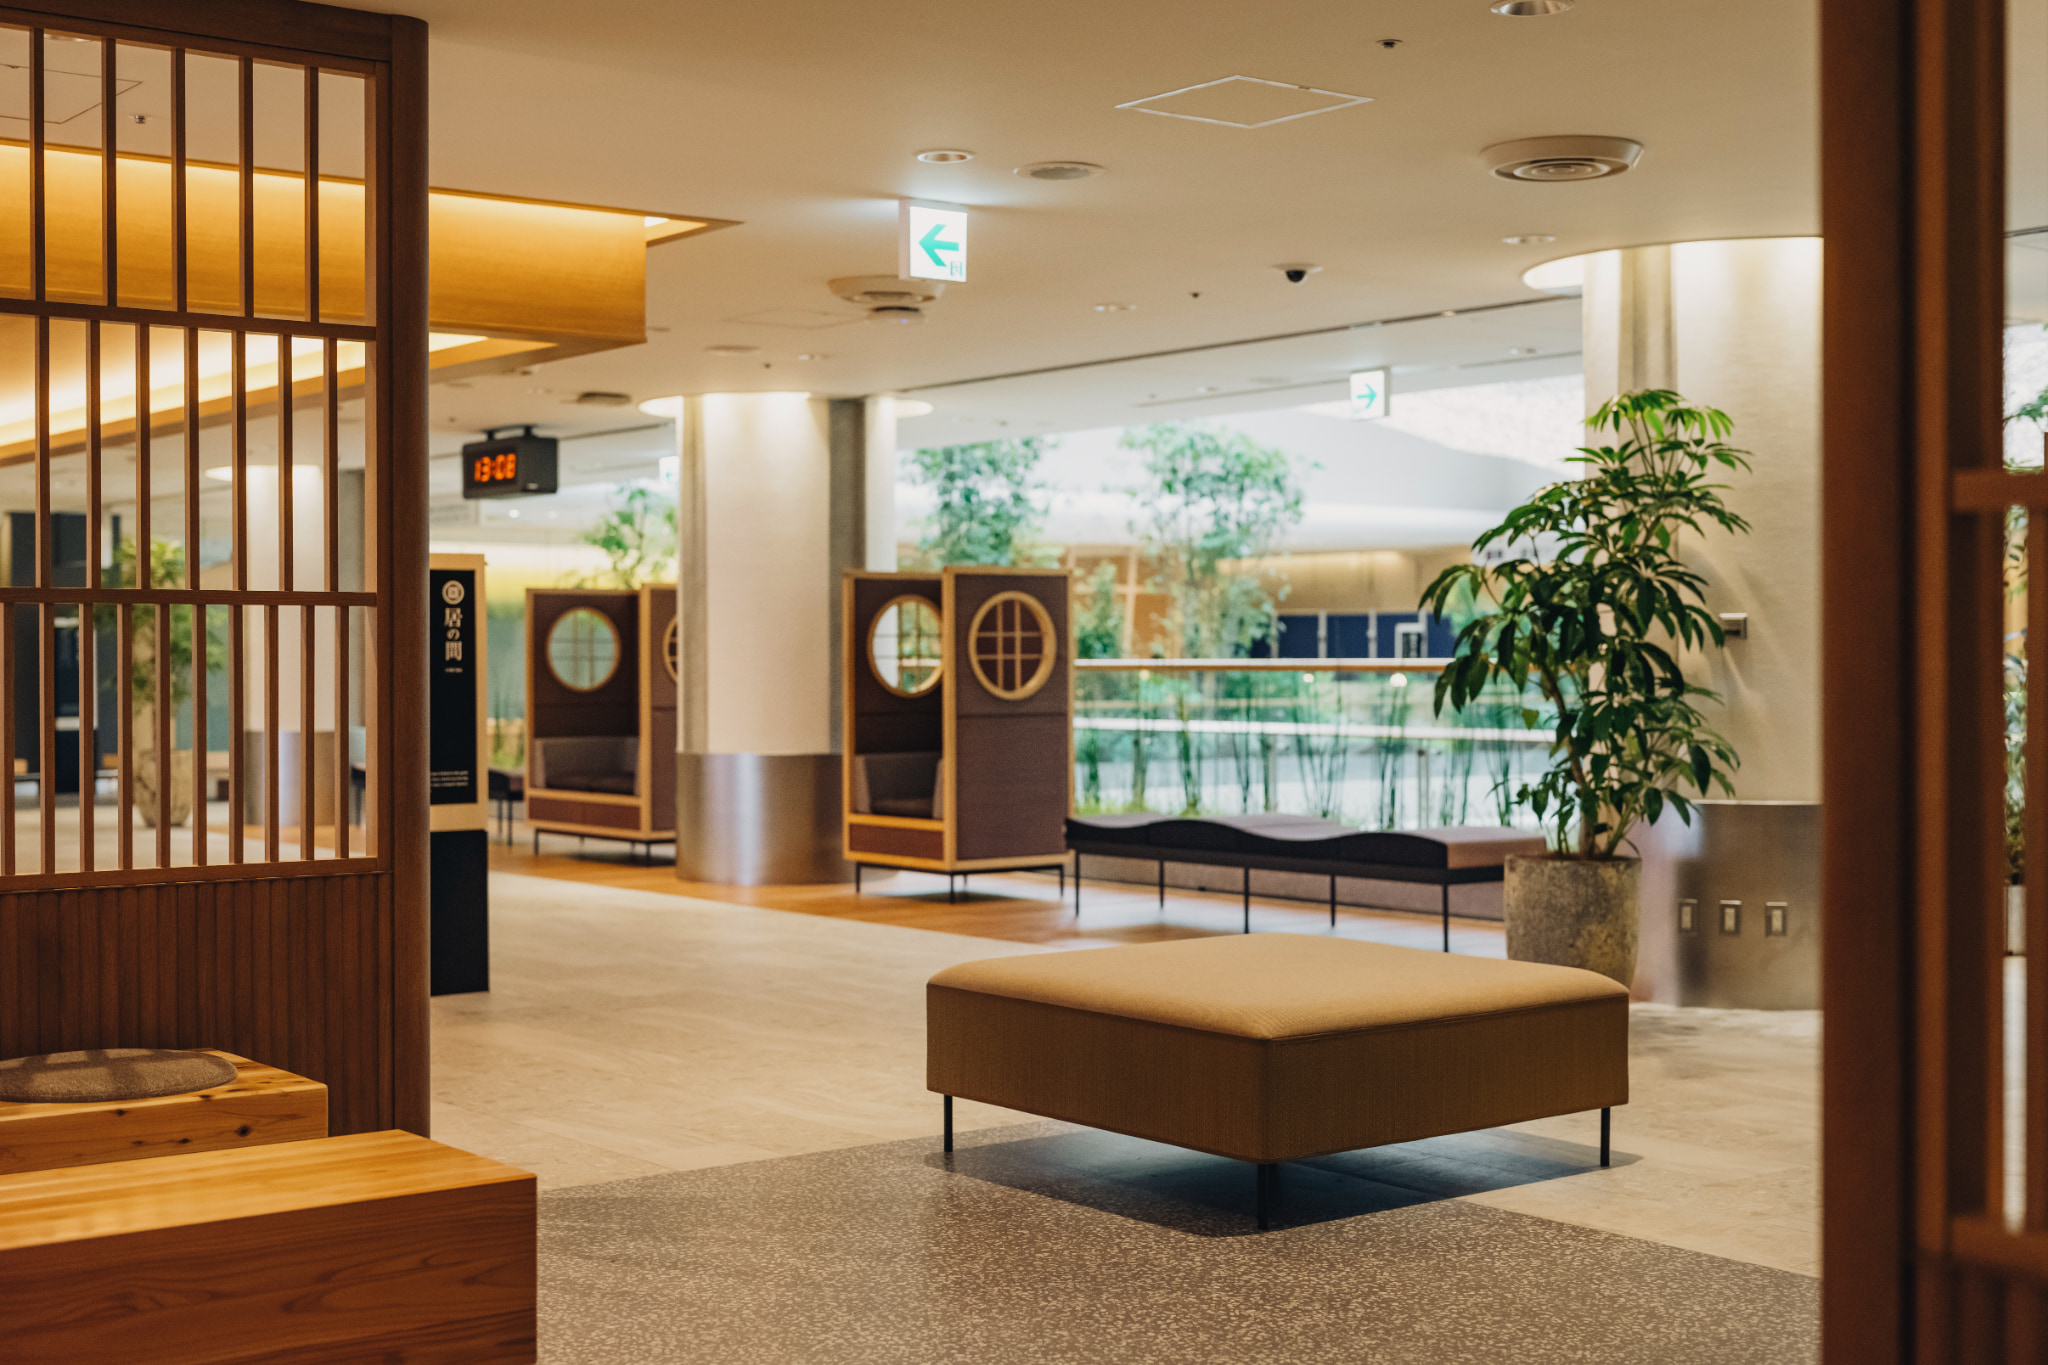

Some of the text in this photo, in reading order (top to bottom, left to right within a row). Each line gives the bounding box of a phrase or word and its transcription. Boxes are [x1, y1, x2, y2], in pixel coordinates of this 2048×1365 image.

[474, 453, 516, 482] 13:08
[444, 607, 463, 661] 居の間
